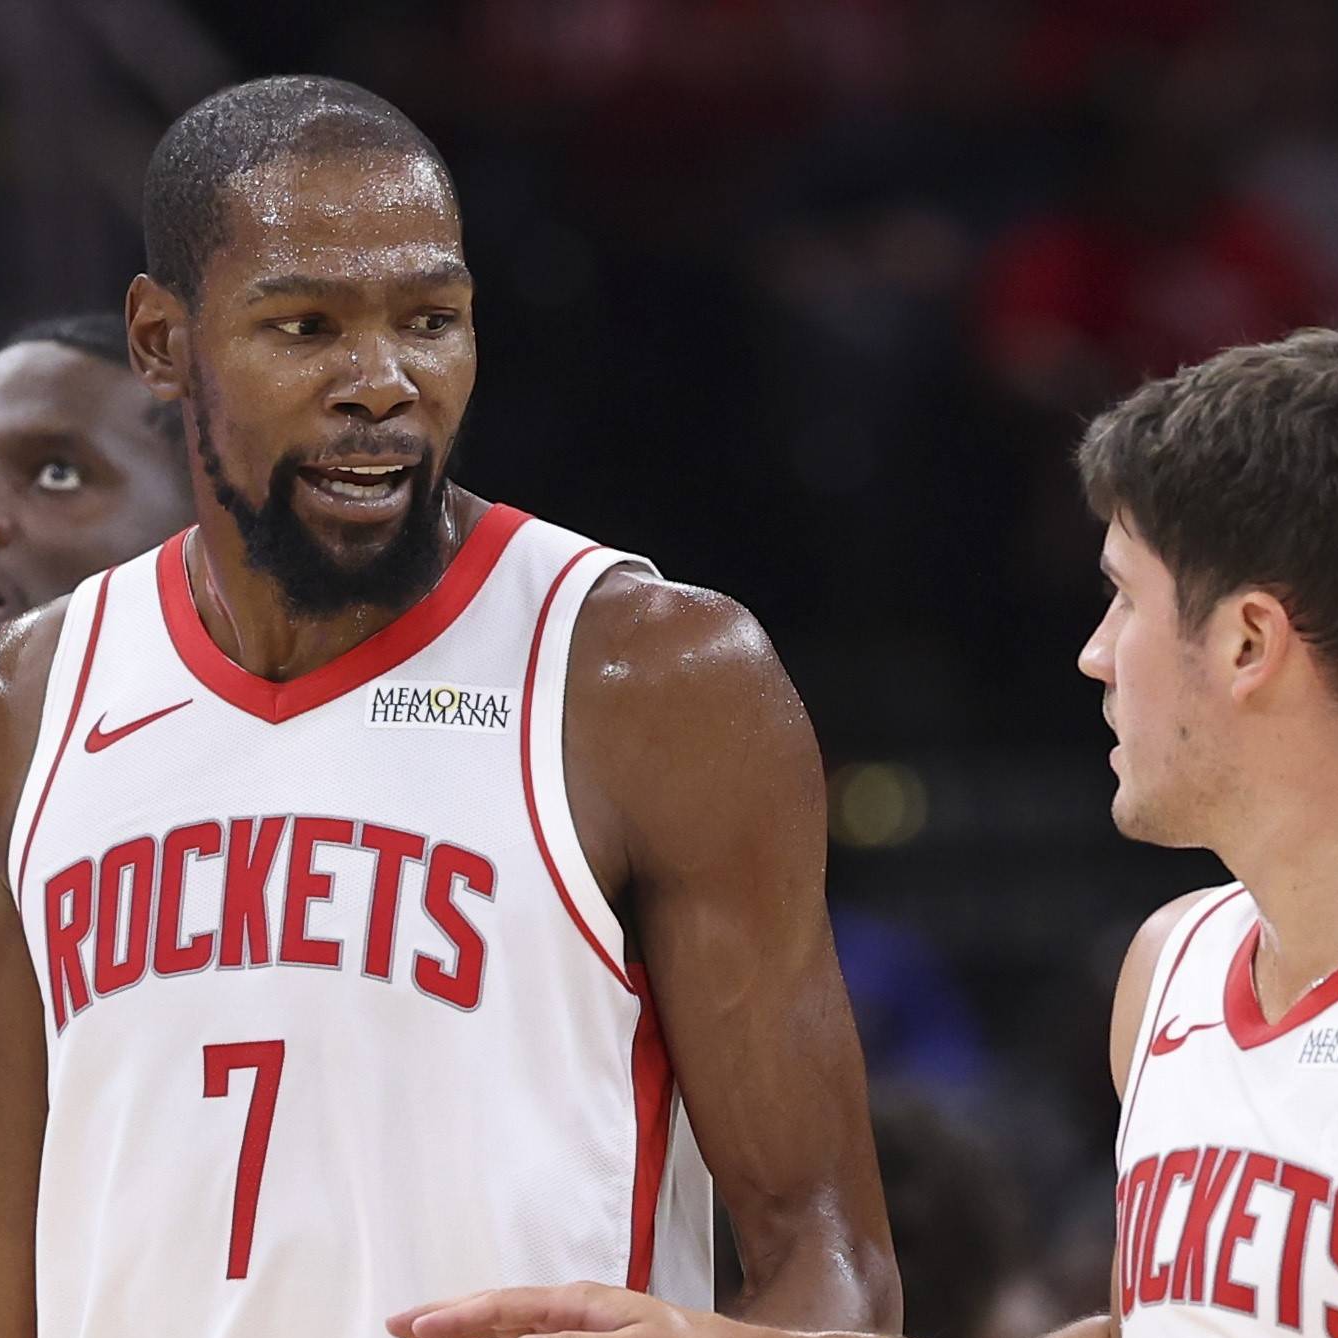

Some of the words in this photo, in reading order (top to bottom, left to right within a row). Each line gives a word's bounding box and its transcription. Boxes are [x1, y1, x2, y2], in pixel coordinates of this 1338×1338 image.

[371, 703, 508, 728] HERMANN
[373, 687, 511, 712] MEMORIAL
[44, 814, 497, 1036] ROCKETS
[203, 1039, 285, 1280] 7
